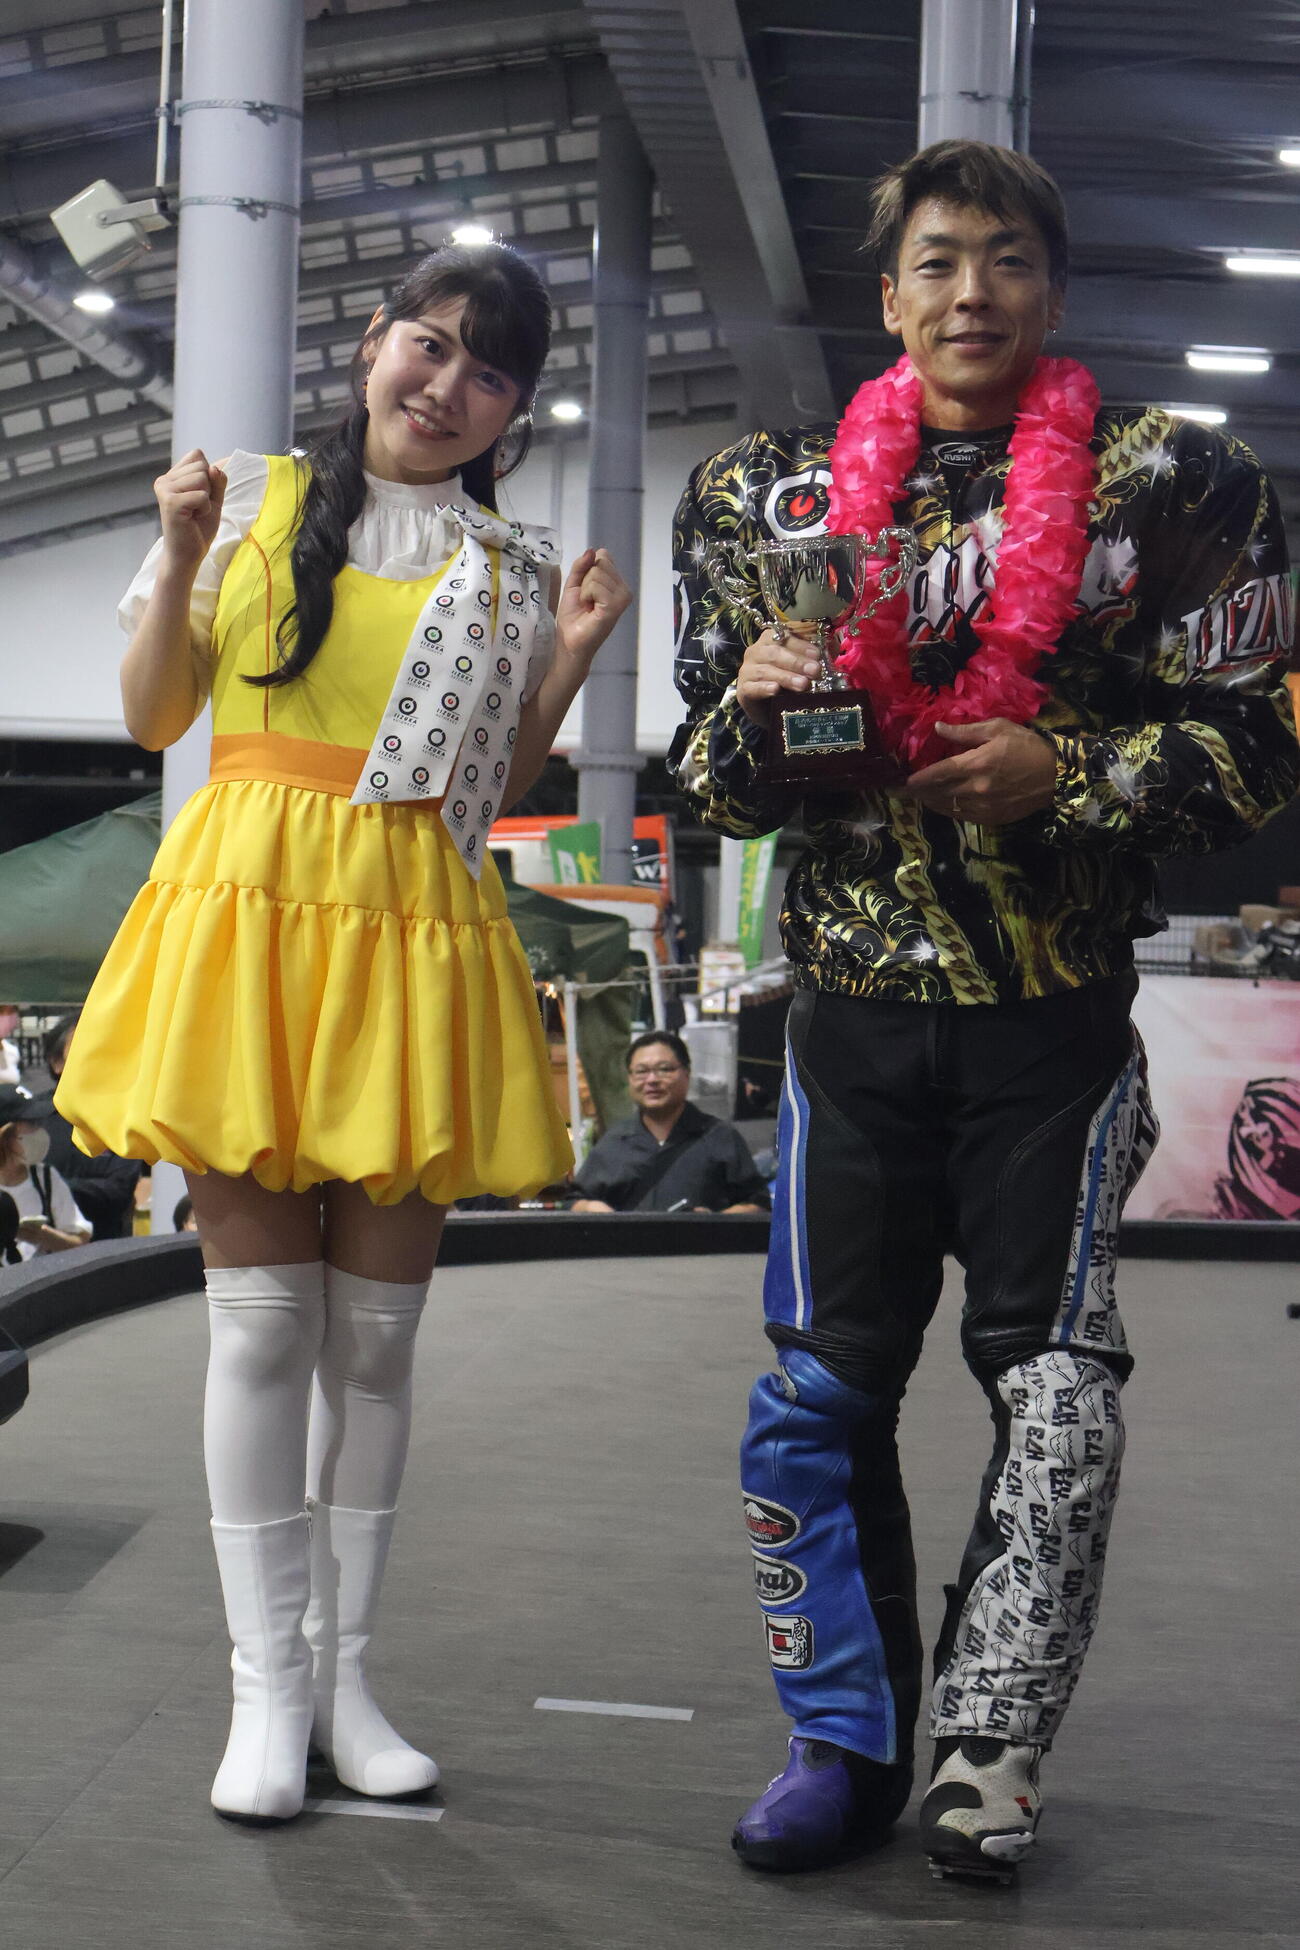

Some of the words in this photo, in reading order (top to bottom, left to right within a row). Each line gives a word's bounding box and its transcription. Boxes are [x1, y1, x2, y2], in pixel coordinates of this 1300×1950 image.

[420, 640, 444, 652] IIZUKA
[407, 677, 430, 688] IIZUKA
[451, 670, 473, 682] IIZUKA
[394, 713, 417, 724] IIZUKA
[436, 708, 459, 721] IIZUKA
[378, 750, 402, 761] IIZUKA
[422, 744, 446, 756] IIZUKA
[365, 786, 389, 798] IIZUKA
[1090, 1229, 1106, 1267] H73
[1084, 1310, 1108, 1342] H73
[1025, 1426, 1045, 1461] H73
[1083, 1429, 1104, 1465] H73
[1006, 1460, 1023, 1497] H73
[1029, 1502, 1049, 1540] H73
[1068, 1501, 1092, 1533] H73
[963, 1624, 986, 1659] H73
[940, 1684, 963, 1720] H73
[985, 1698, 1014, 1731] H73
